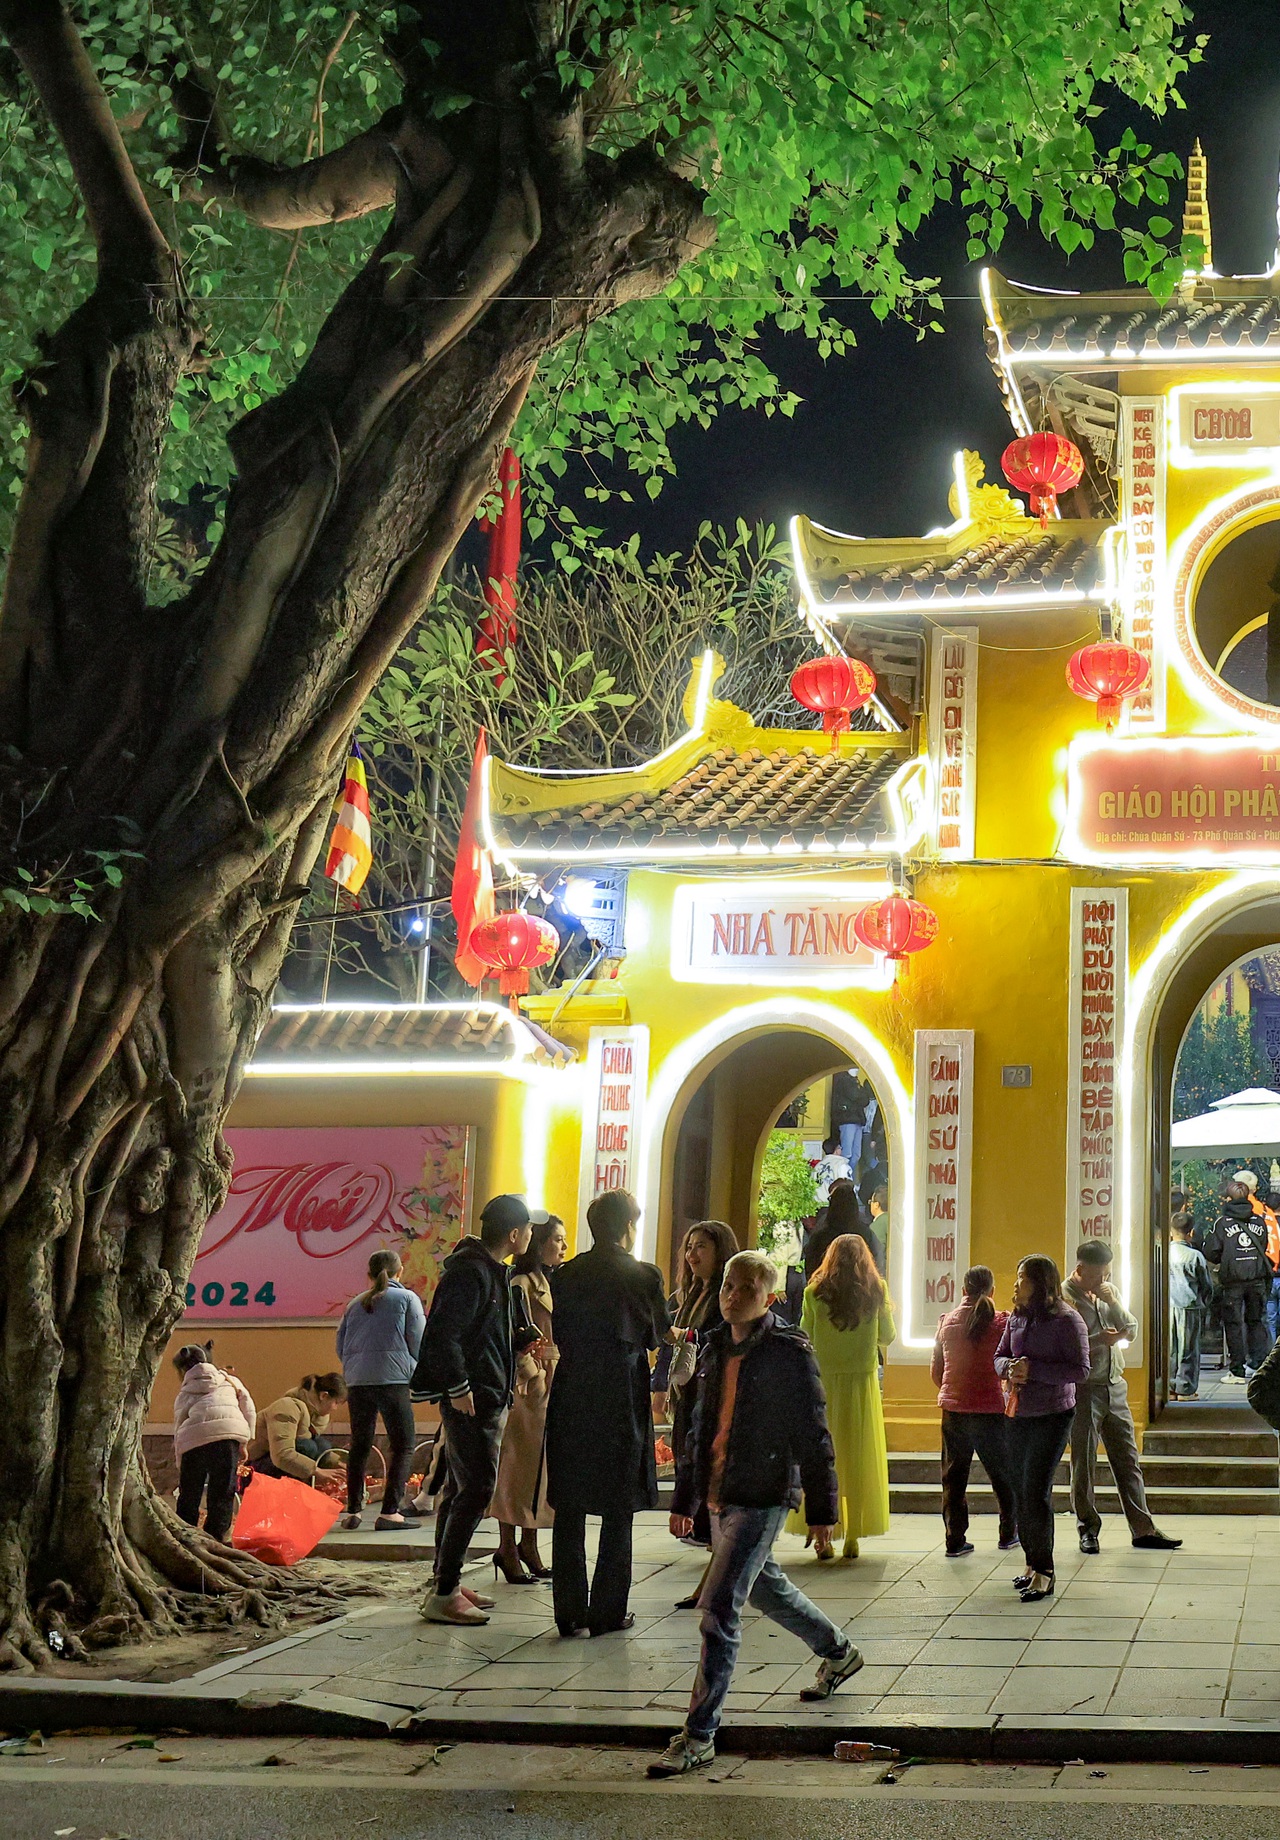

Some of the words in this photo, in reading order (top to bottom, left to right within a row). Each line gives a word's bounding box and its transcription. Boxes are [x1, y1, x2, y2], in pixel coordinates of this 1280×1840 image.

[1134, 483, 1152, 497] BA
[1098, 785, 1162, 819] GIÁO
[1171, 783, 1216, 823] HỘI
[1193, 830, 1203, 841] 73
[1083, 900, 1115, 924] HỘI
[710, 908, 777, 956] NHÀ
[1006, 1068, 1026, 1084] 73
[1081, 1133, 1113, 1156] PHÚC
[1081, 1184, 1112, 1207] SƠ
